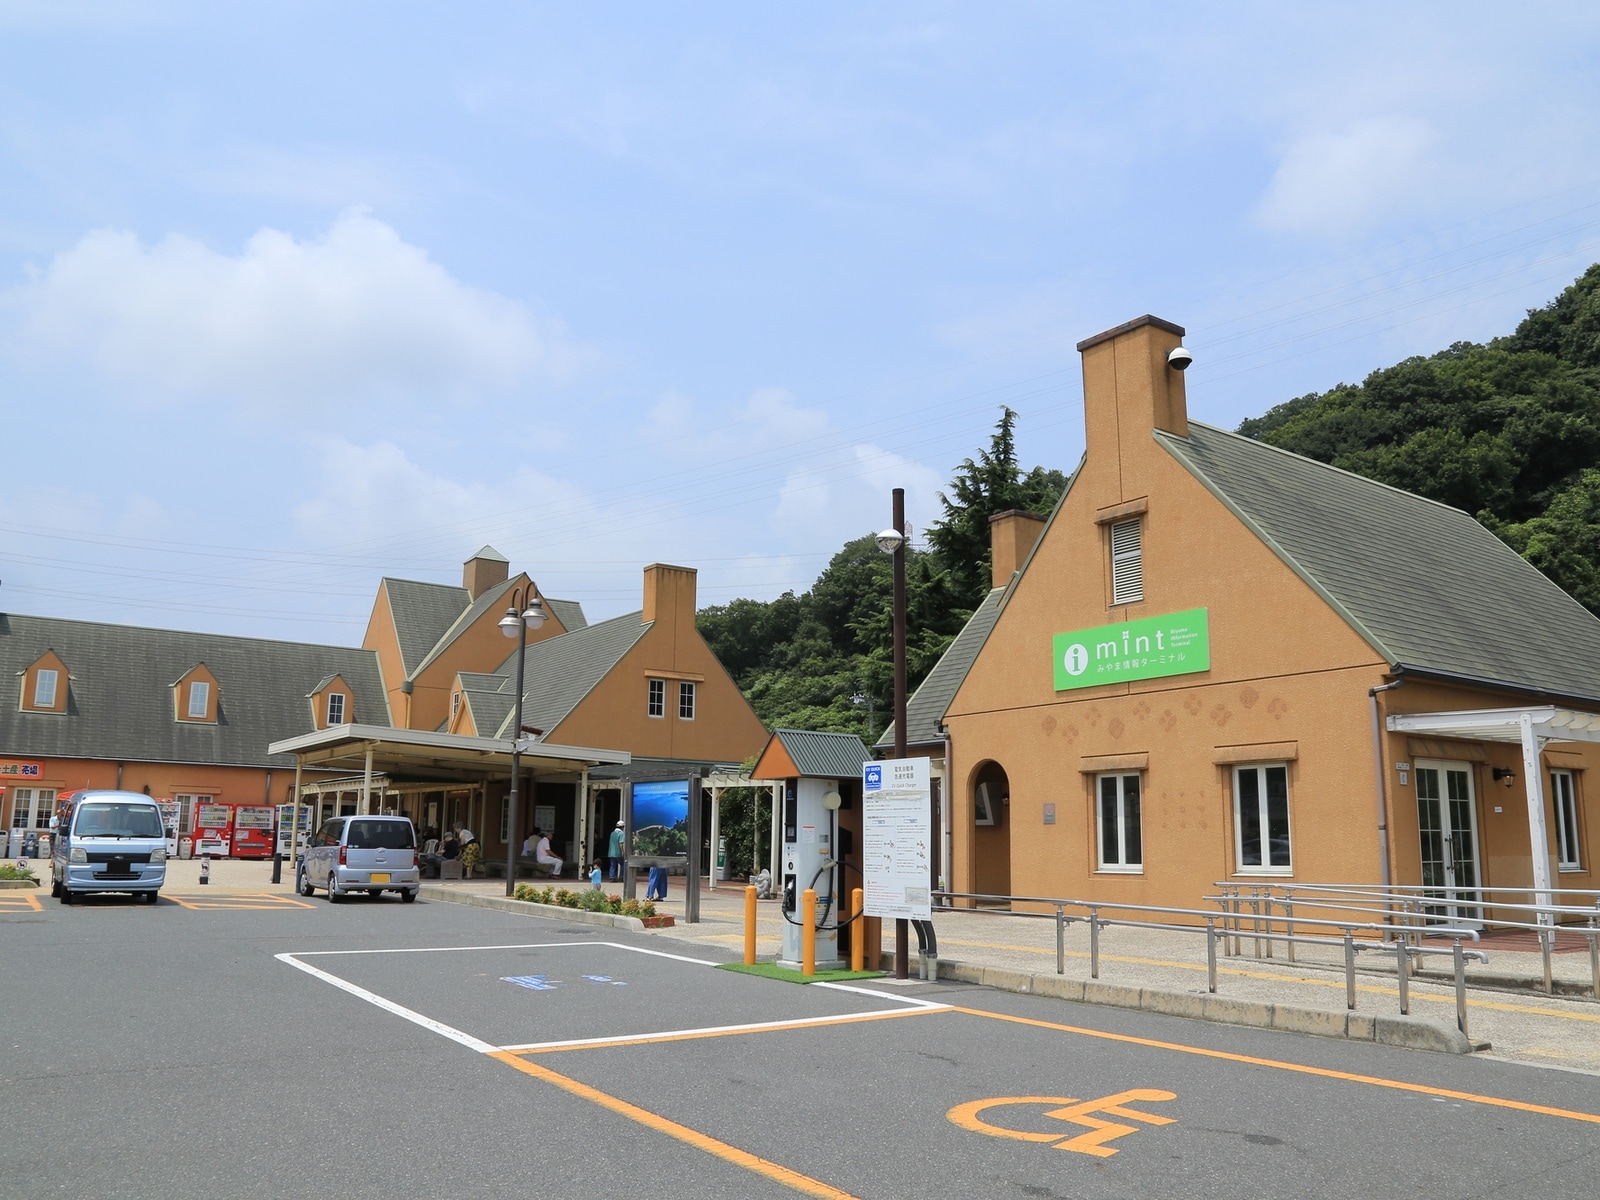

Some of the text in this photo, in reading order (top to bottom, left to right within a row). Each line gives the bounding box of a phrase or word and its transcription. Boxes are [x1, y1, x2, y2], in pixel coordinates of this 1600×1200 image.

[1096, 630, 1165, 660] mint
[1097, 652, 1186, 673] みやま情報ターミナル
[0, 764, 19, 775] 土産
